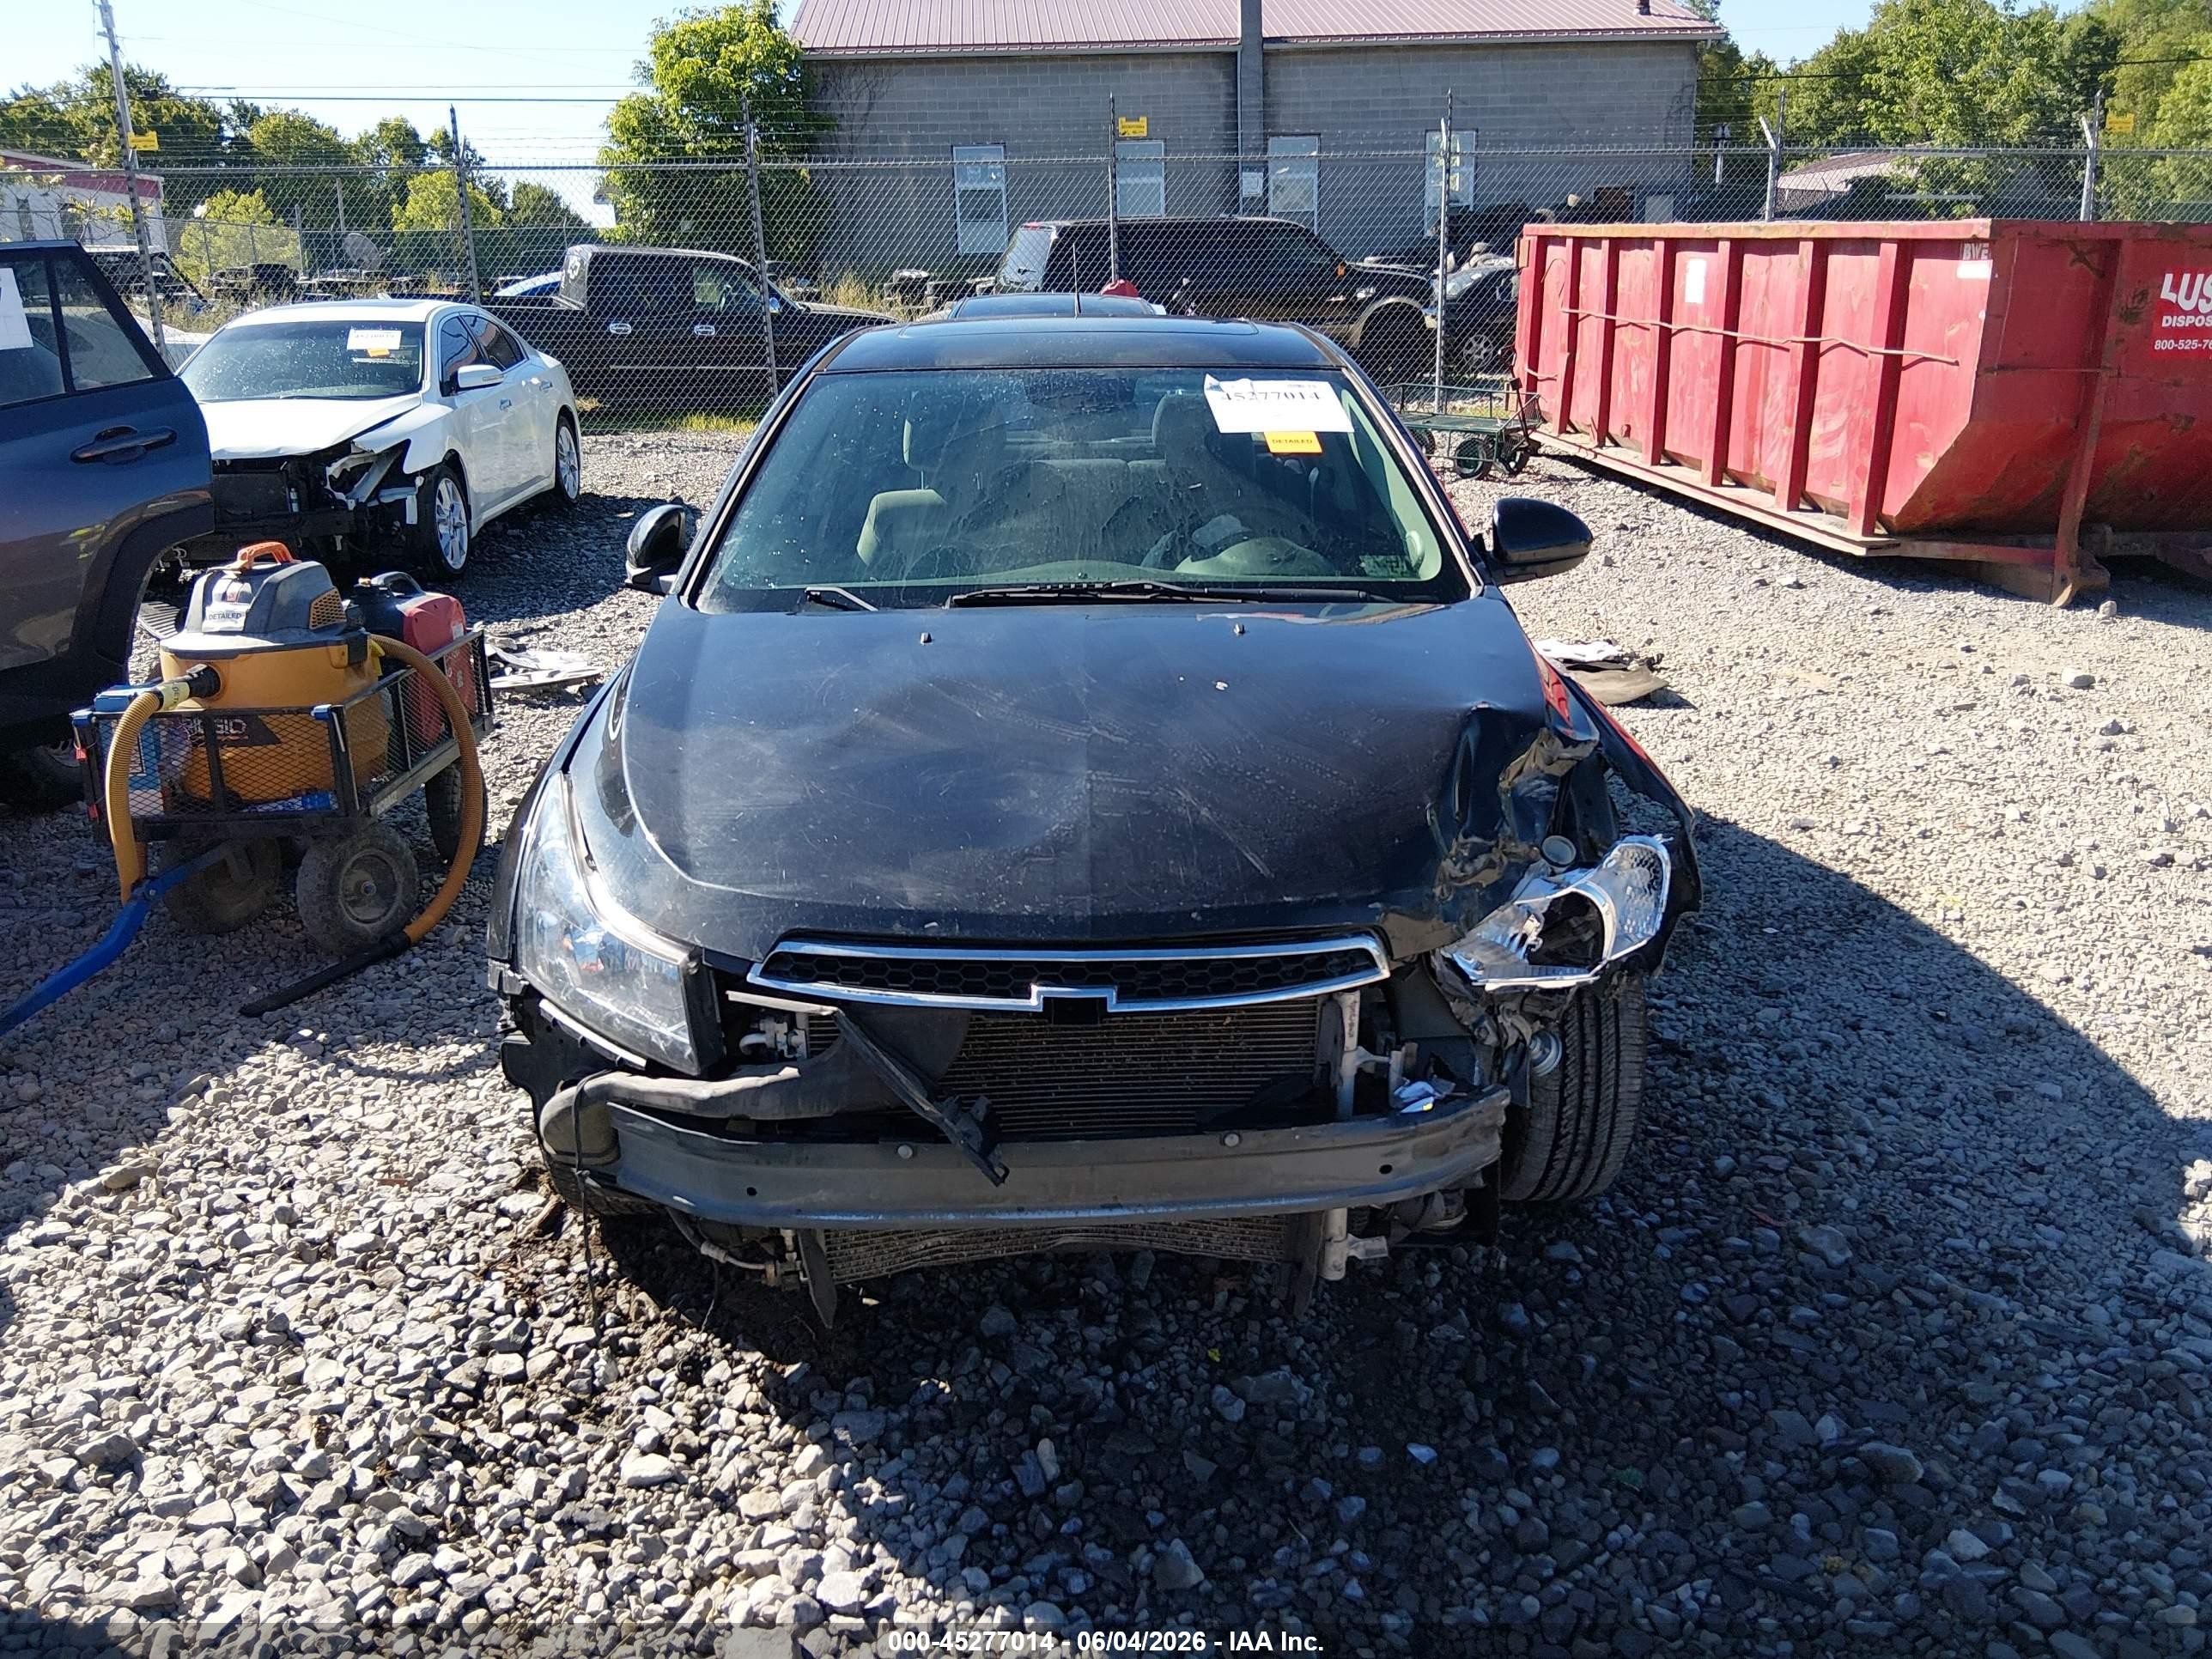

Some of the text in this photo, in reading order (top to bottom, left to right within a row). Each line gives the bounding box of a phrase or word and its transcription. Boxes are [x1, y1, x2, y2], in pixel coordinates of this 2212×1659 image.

[2161, 315, 2212, 327] DISPOS
[1221, 391, 1322, 401] 45277014
[209, 611, 242, 620] DETAILED
